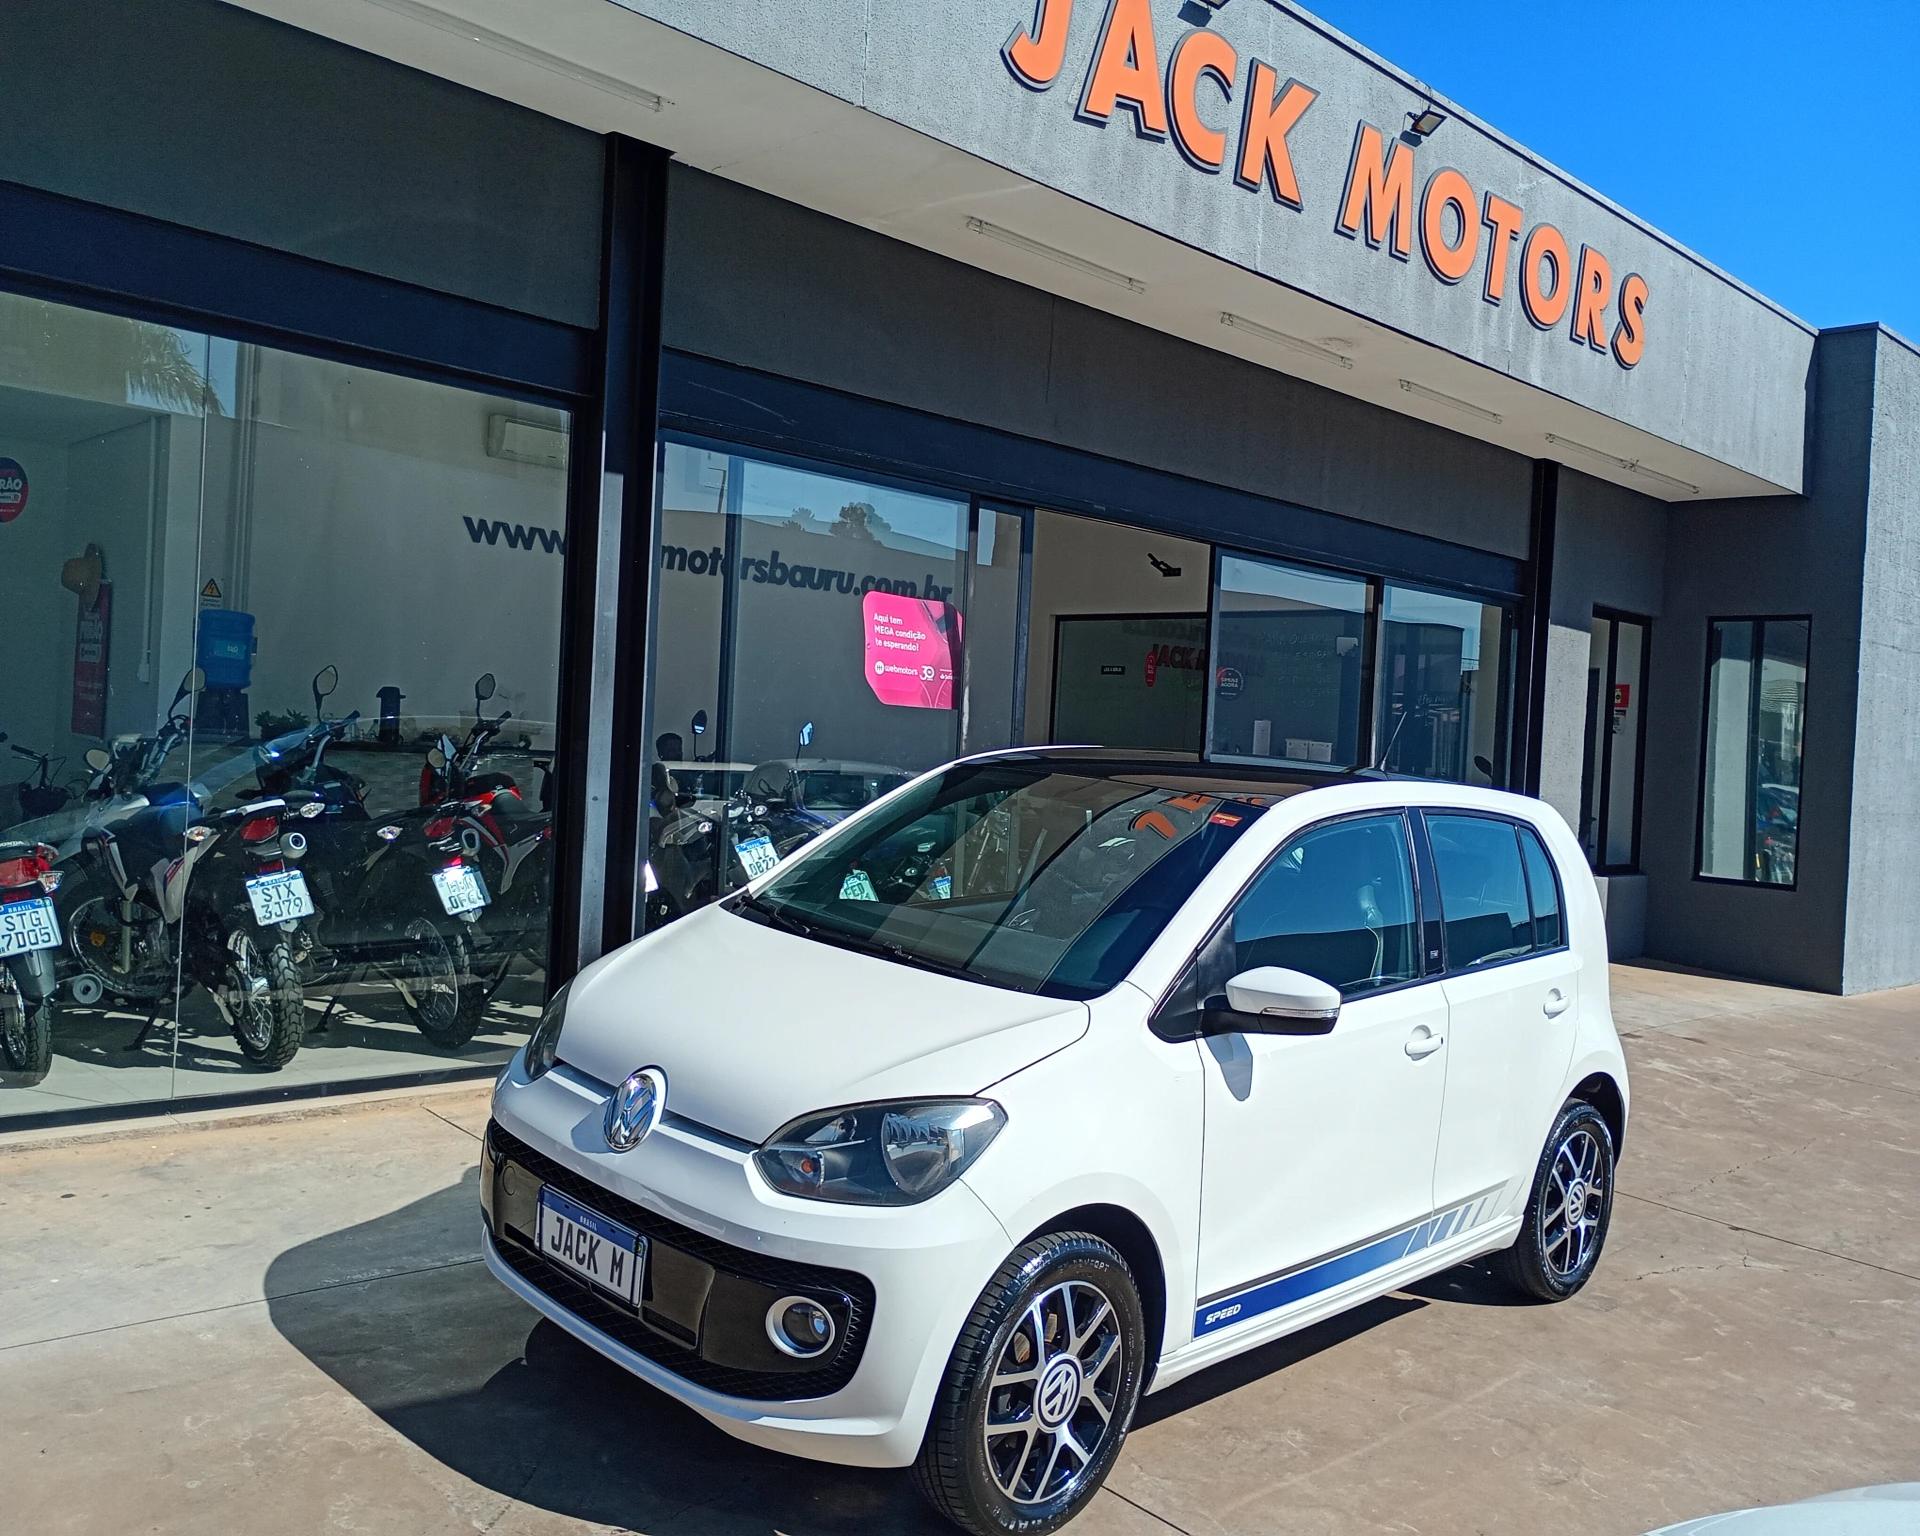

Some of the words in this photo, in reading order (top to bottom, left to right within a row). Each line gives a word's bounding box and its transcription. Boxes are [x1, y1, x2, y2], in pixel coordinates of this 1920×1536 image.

[1000, 0, 1320, 212] JACK
[1335, 119, 1649, 368] MOTORS
[873, 613, 889, 624] Aqui
[889, 616, 903, 626] tem
[874, 625, 894, 635] MEGA
[895, 630, 926, 641] condição
[875, 637, 883, 647] te
[885, 664, 918, 676] webmotors
[920, 665, 935, 681] 30
[261, 882, 296, 903] STX
[7, 904, 33, 913] BRASIL
[260, 896, 303, 920] 3J79
[4, 910, 42, 932] STG
[579, 1215, 597, 1231] BRASIL
[550, 1215, 601, 1275] JACK
[609, 1245, 625, 1288] M
[1204, 1303, 1242, 1325] SPEED
